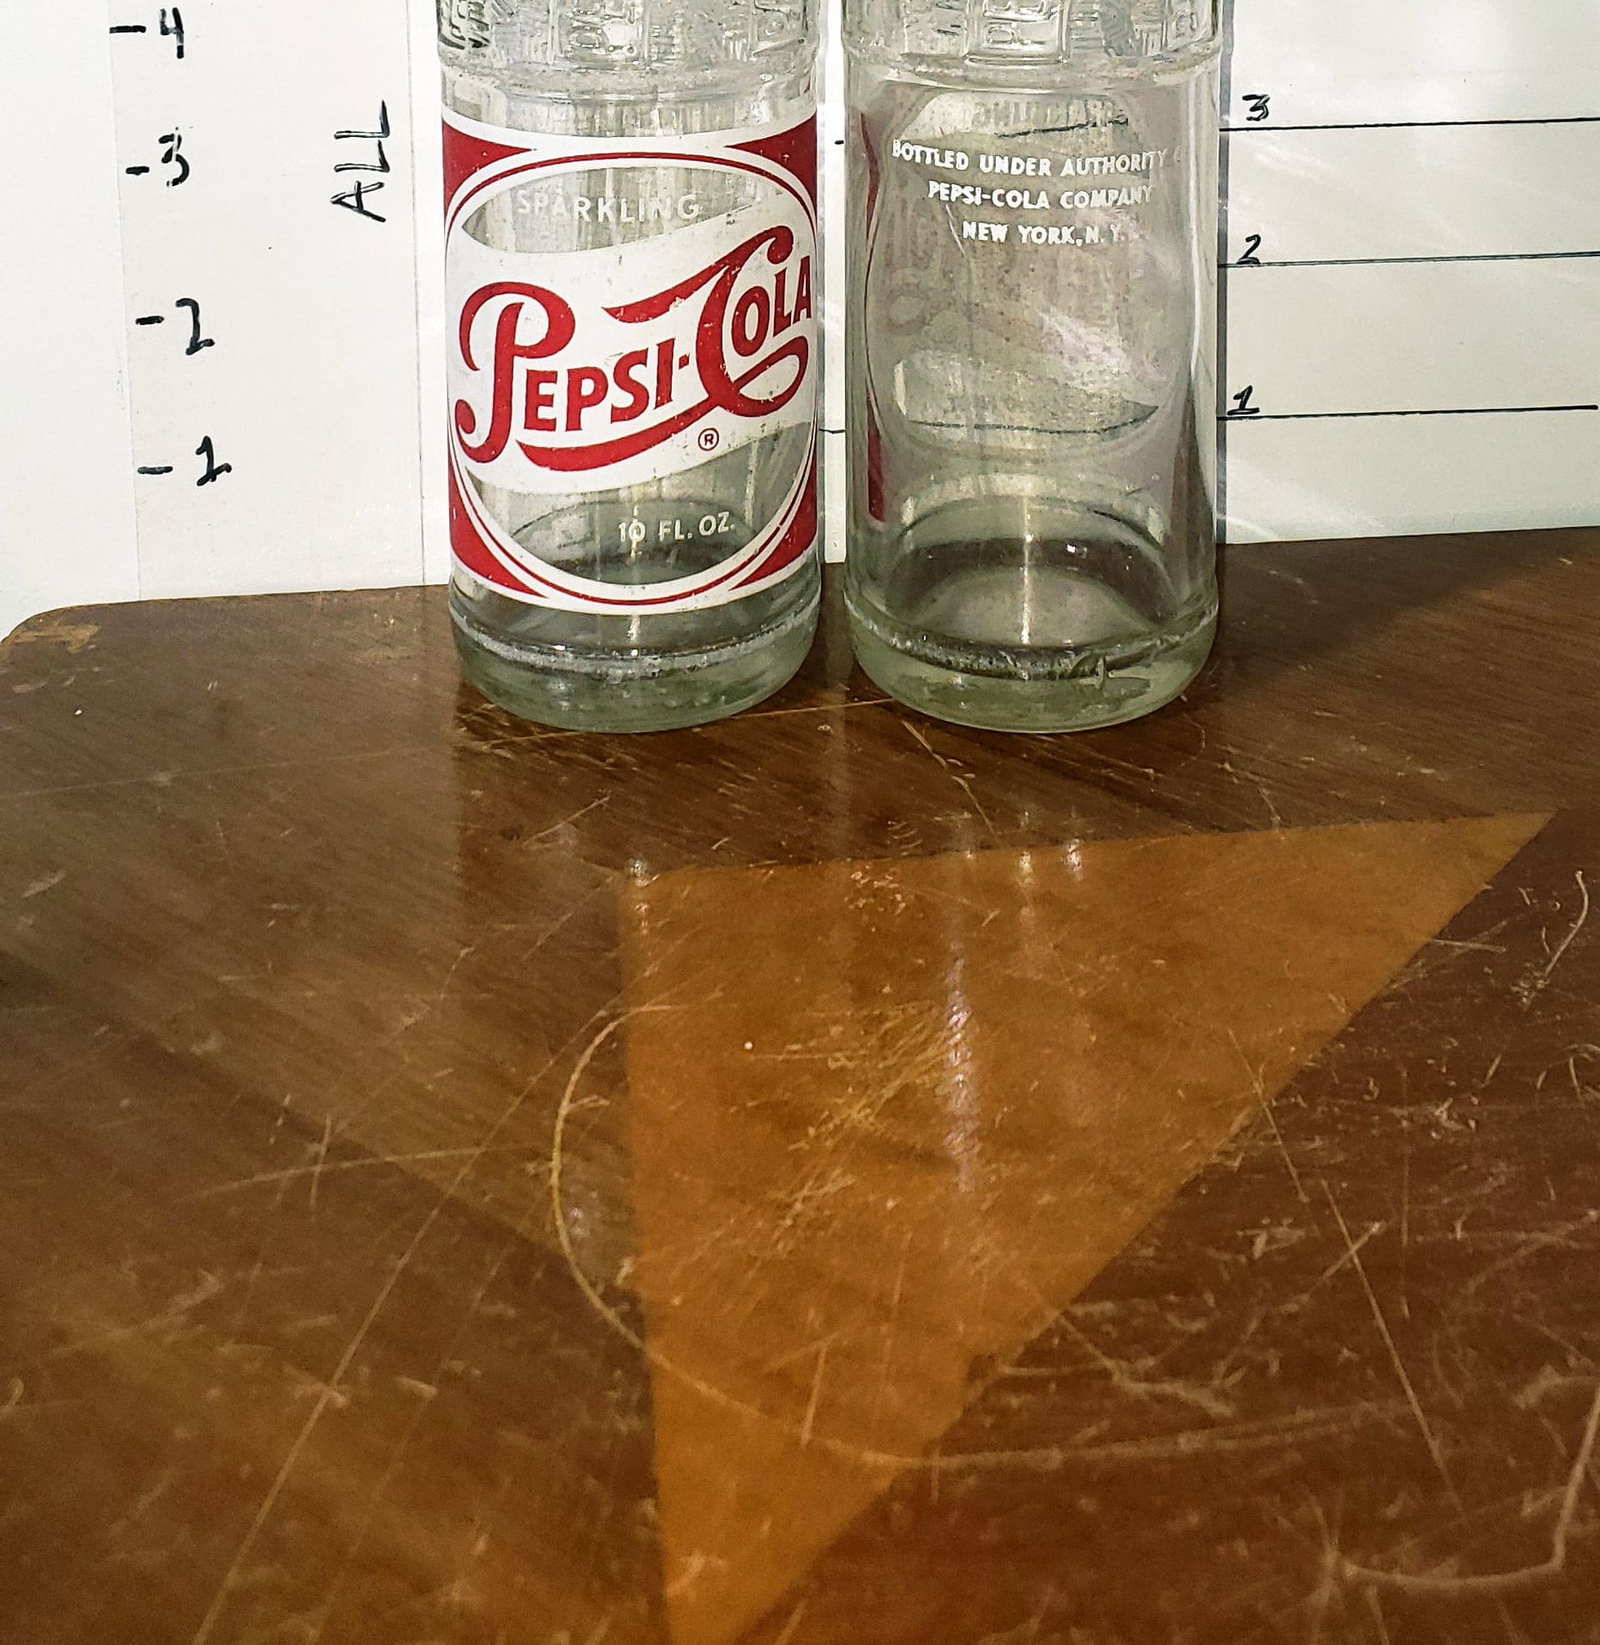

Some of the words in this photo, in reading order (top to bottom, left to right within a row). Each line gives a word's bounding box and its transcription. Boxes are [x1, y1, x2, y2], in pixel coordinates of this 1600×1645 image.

[159, 8, 185, 59] 4
[1242, 95, 1270, 121] 3
[159, 129, 190, 186] 3
[331, 101, 390, 222] ALL
[892, 140, 968, 171] BOTTLED
[979, 155, 1051, 177] UNDER
[1060, 148, 1168, 177] AUTHORITY
[517, 191, 701, 223] SPARKLING
[928, 180, 1049, 210] PEPSI-COLA
[1060, 185, 1152, 209] COMPANY
[962, 221, 1008, 242] NEW
[1236, 234, 1260, 264] 2
[176, 298, 215, 355] 2
[454, 225, 812, 471] PEPSI-COLA
[1227, 385, 1260, 415] 1
[196, 436, 232, 486] 1
[618, 522, 646, 542] 10
[659, 520, 693, 541] FL.
[699, 511, 735, 536] OZ.
